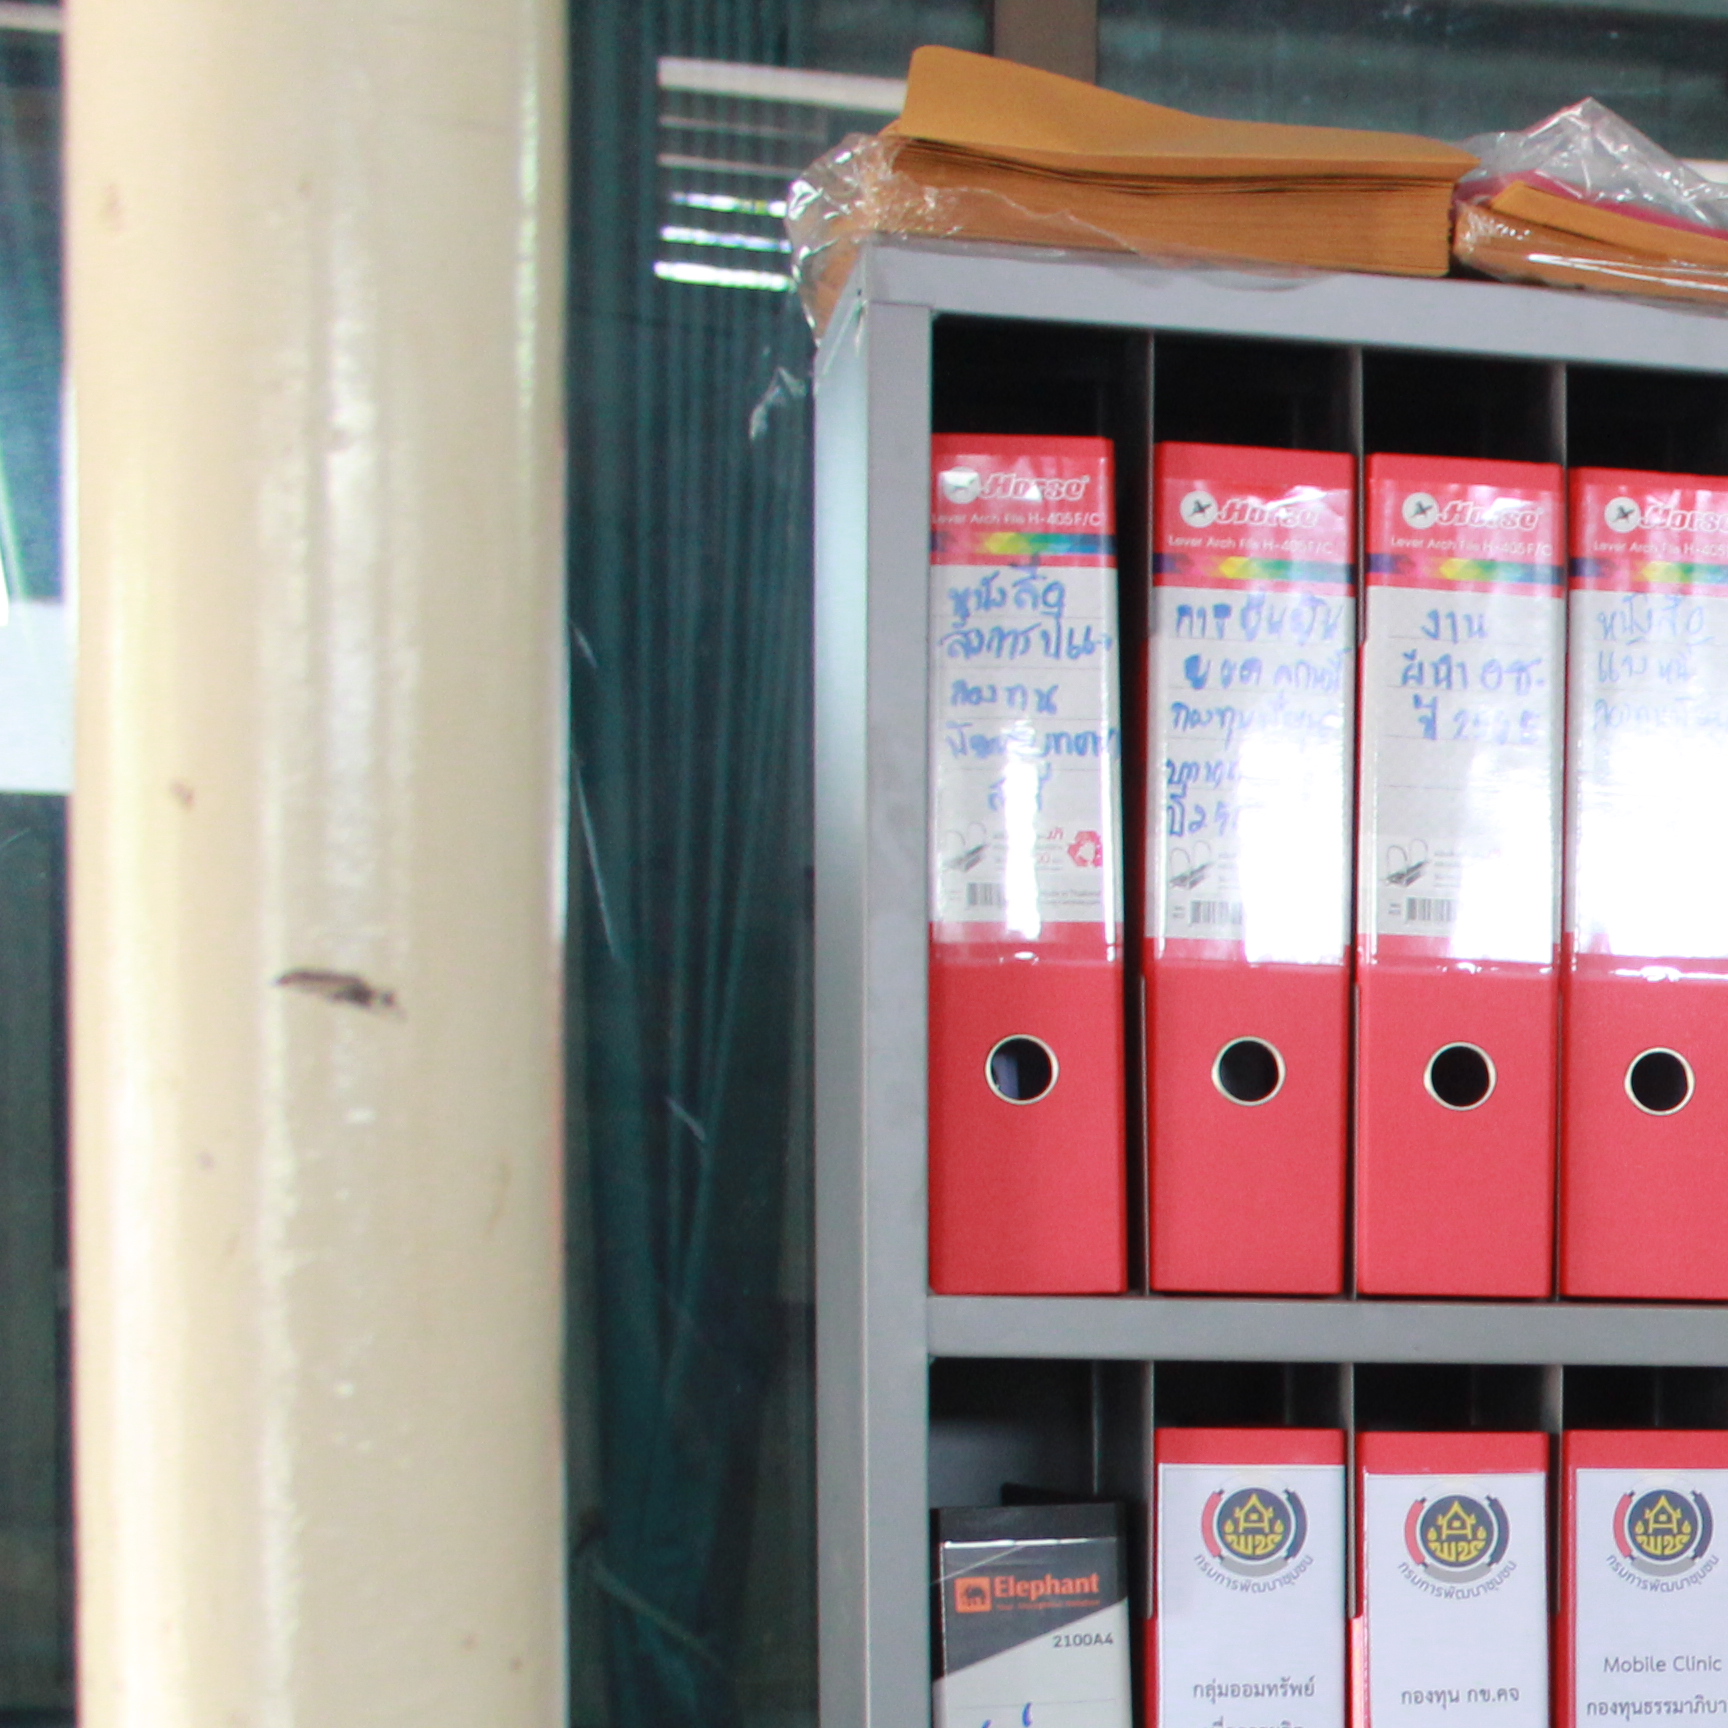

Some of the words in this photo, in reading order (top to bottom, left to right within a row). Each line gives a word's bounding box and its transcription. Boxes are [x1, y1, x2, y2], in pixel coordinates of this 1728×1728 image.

[1421, 608, 1488, 645] งาน
[994, 1573, 1100, 1600] Elephant
[1193, 1553, 1314, 1595] กรมการพัฒนาชุมชน
[1397, 1559, 1517, 1600] กรมการพัฒนาชุมชน
[1605, 1554, 1720, 1593] กรมการพัฒนาชุมชน
[1053, 1632, 1113, 1648] 2100A4
[1604, 1655, 1666, 1674] Mobile
[1673, 1655, 1722, 1674] Clinic
[1192, 1675, 1315, 1706] กลุ่มออมทรัพย์
[1400, 1686, 1459, 1710] กองทุน
[1466, 1685, 1520, 1705] กข.คจ
